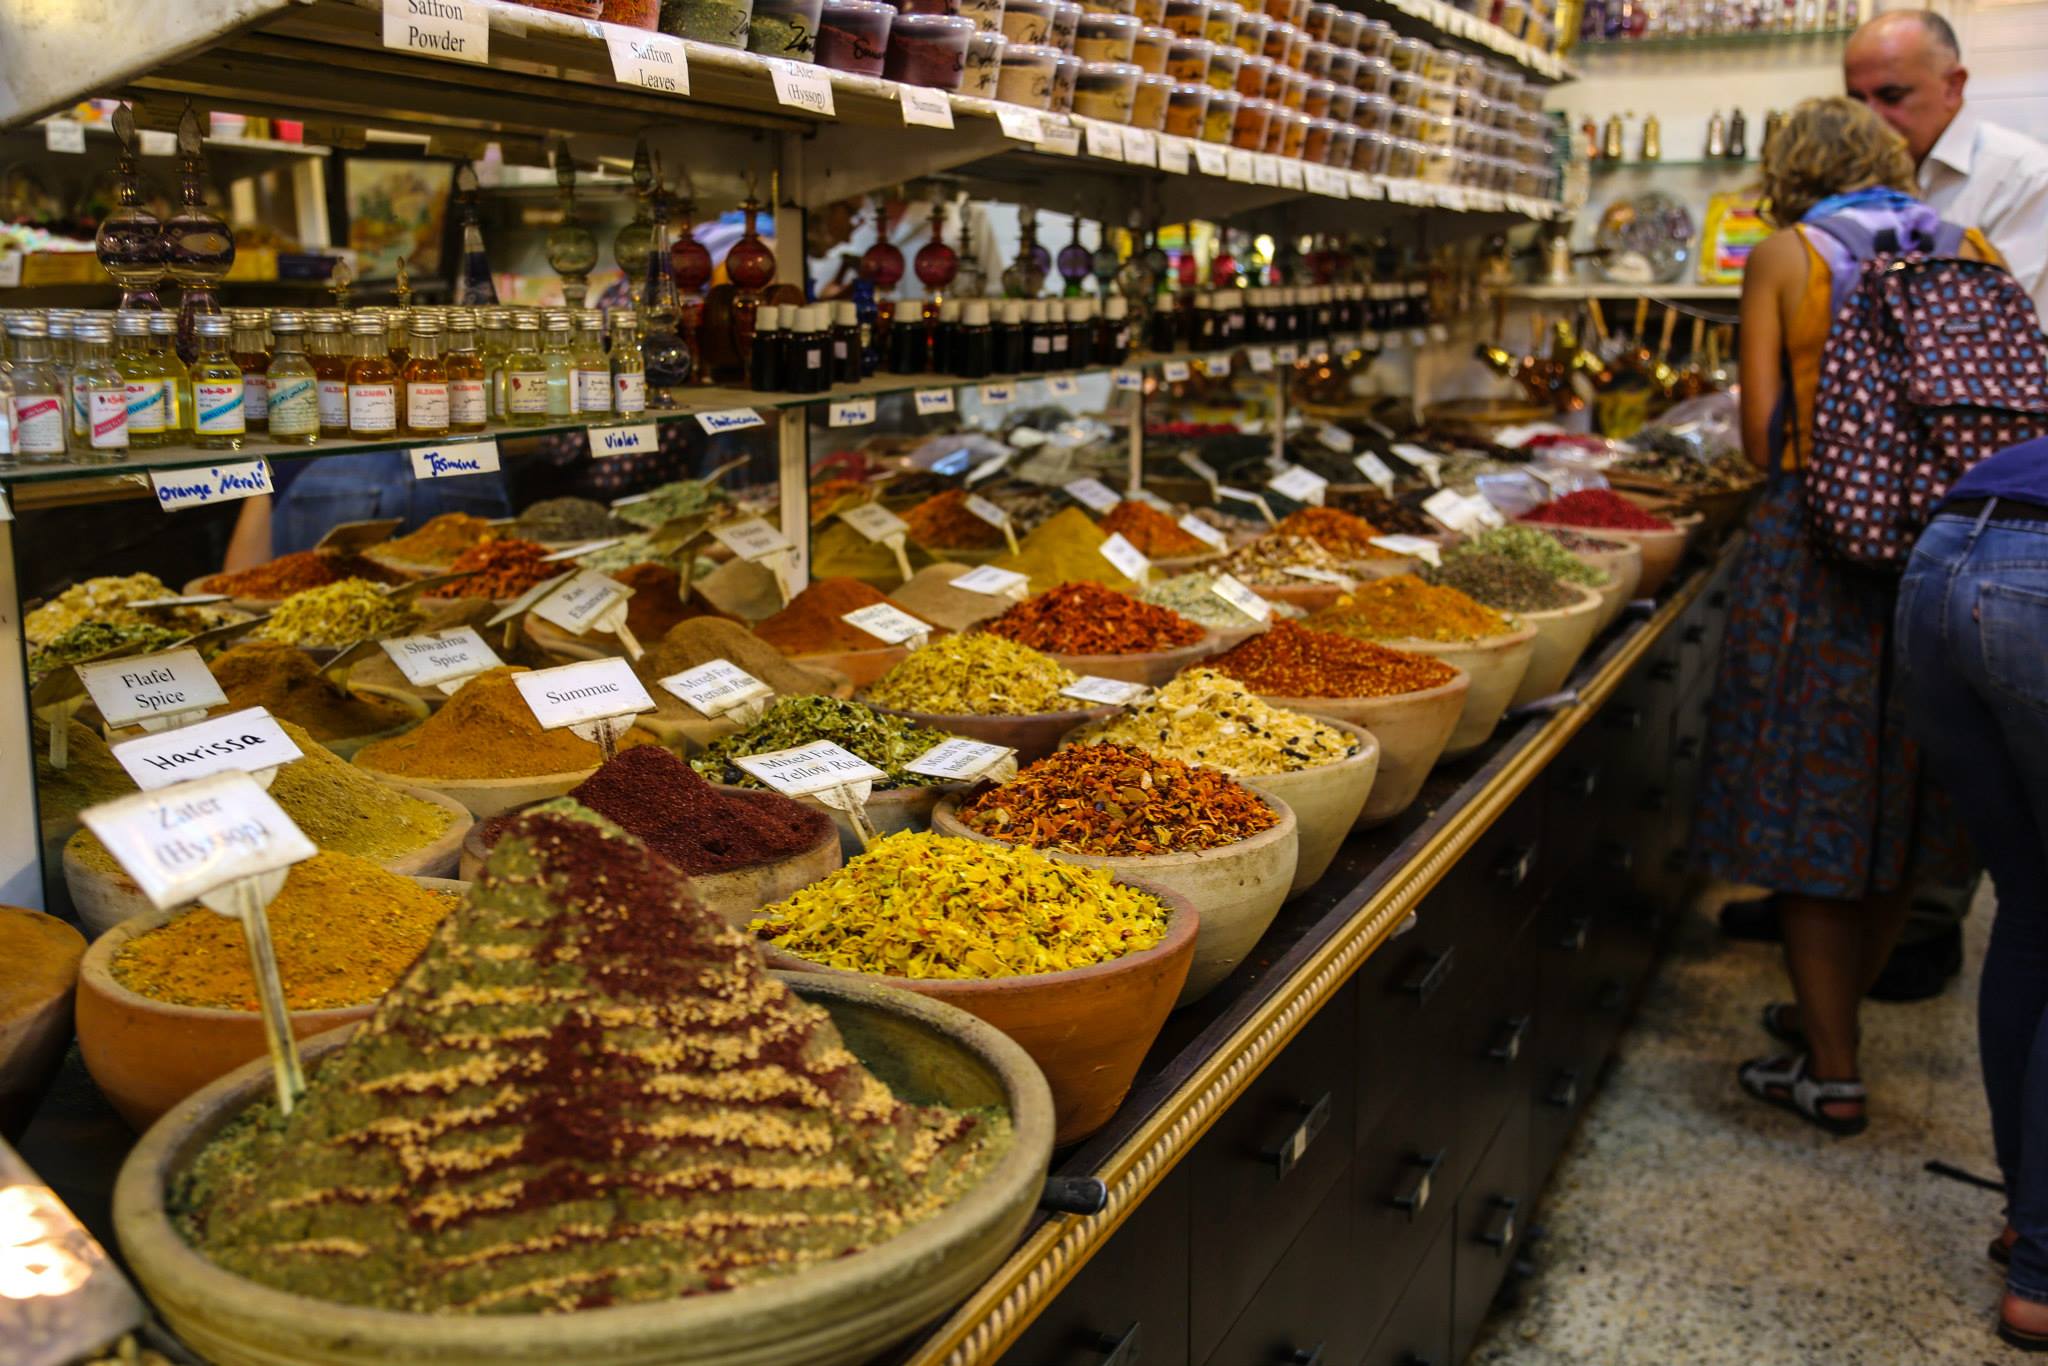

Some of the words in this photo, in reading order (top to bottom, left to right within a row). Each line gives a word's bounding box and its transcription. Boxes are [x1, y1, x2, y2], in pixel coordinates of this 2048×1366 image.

[408, 0, 463, 21] Saffron
[408, 25, 465, 52] Powder
[629, 41, 673, 64] Saffron
[638, 68, 676, 91] Leaves
[787, 82, 826, 110] (Hyssop)
[605, 432, 639, 448] Violet
[159, 483, 212, 502] Orange
[430, 652, 468, 668] Spice
[121, 668, 176, 688] Flafel
[135, 689, 185, 711] Spice
[546, 680, 619, 705] Summac
[143, 733, 266, 770] Harissa
[760, 751, 809, 770] Mixed
[811, 748, 839, 760] For
[773, 763, 831, 783] Yellow
[834, 758, 867, 771] Rice
